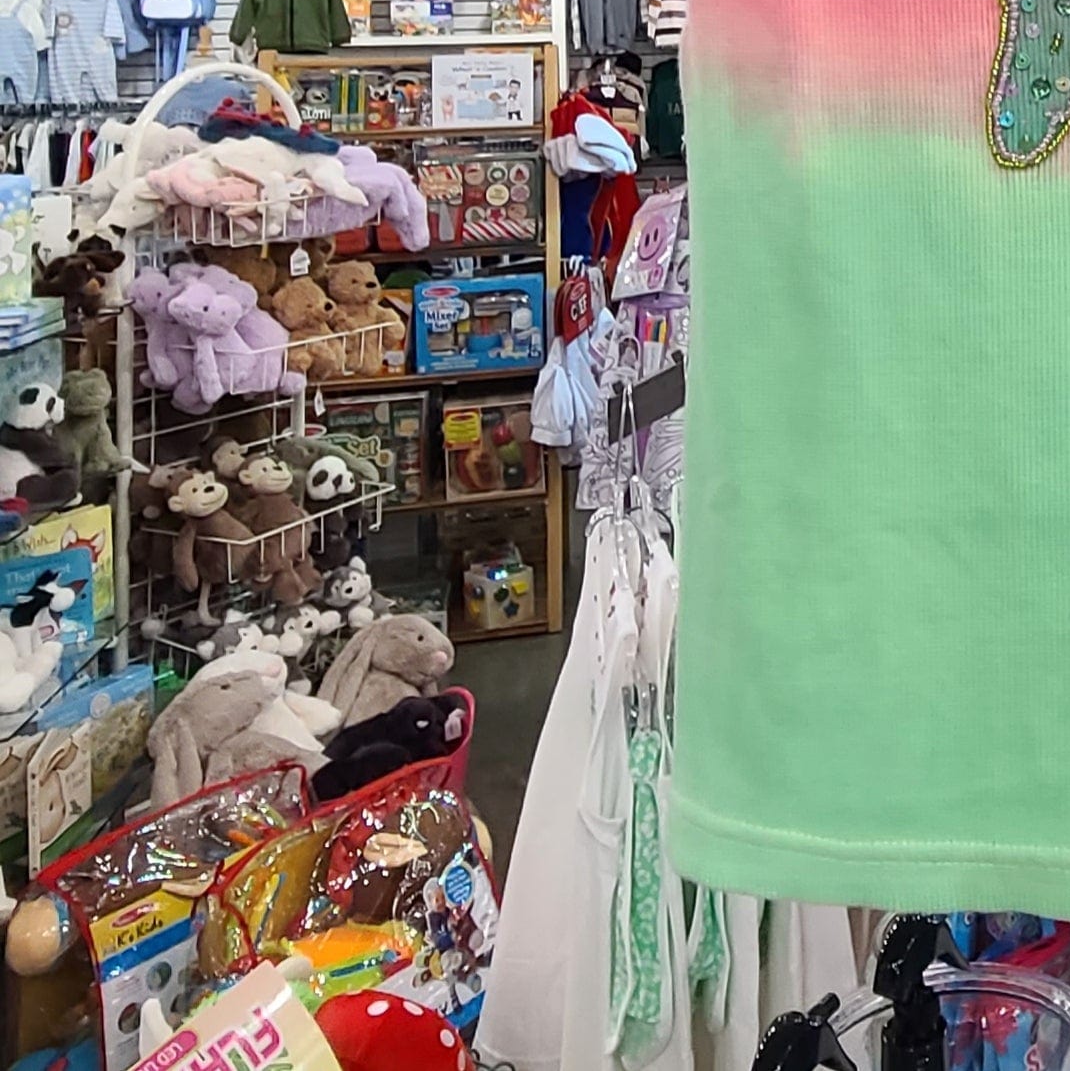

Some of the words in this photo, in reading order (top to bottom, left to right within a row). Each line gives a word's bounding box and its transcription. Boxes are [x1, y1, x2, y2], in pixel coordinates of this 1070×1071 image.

[426, 311, 457, 322] Mixer
[346, 436, 378, 457] Set
[136, 914, 164, 938] Kids
